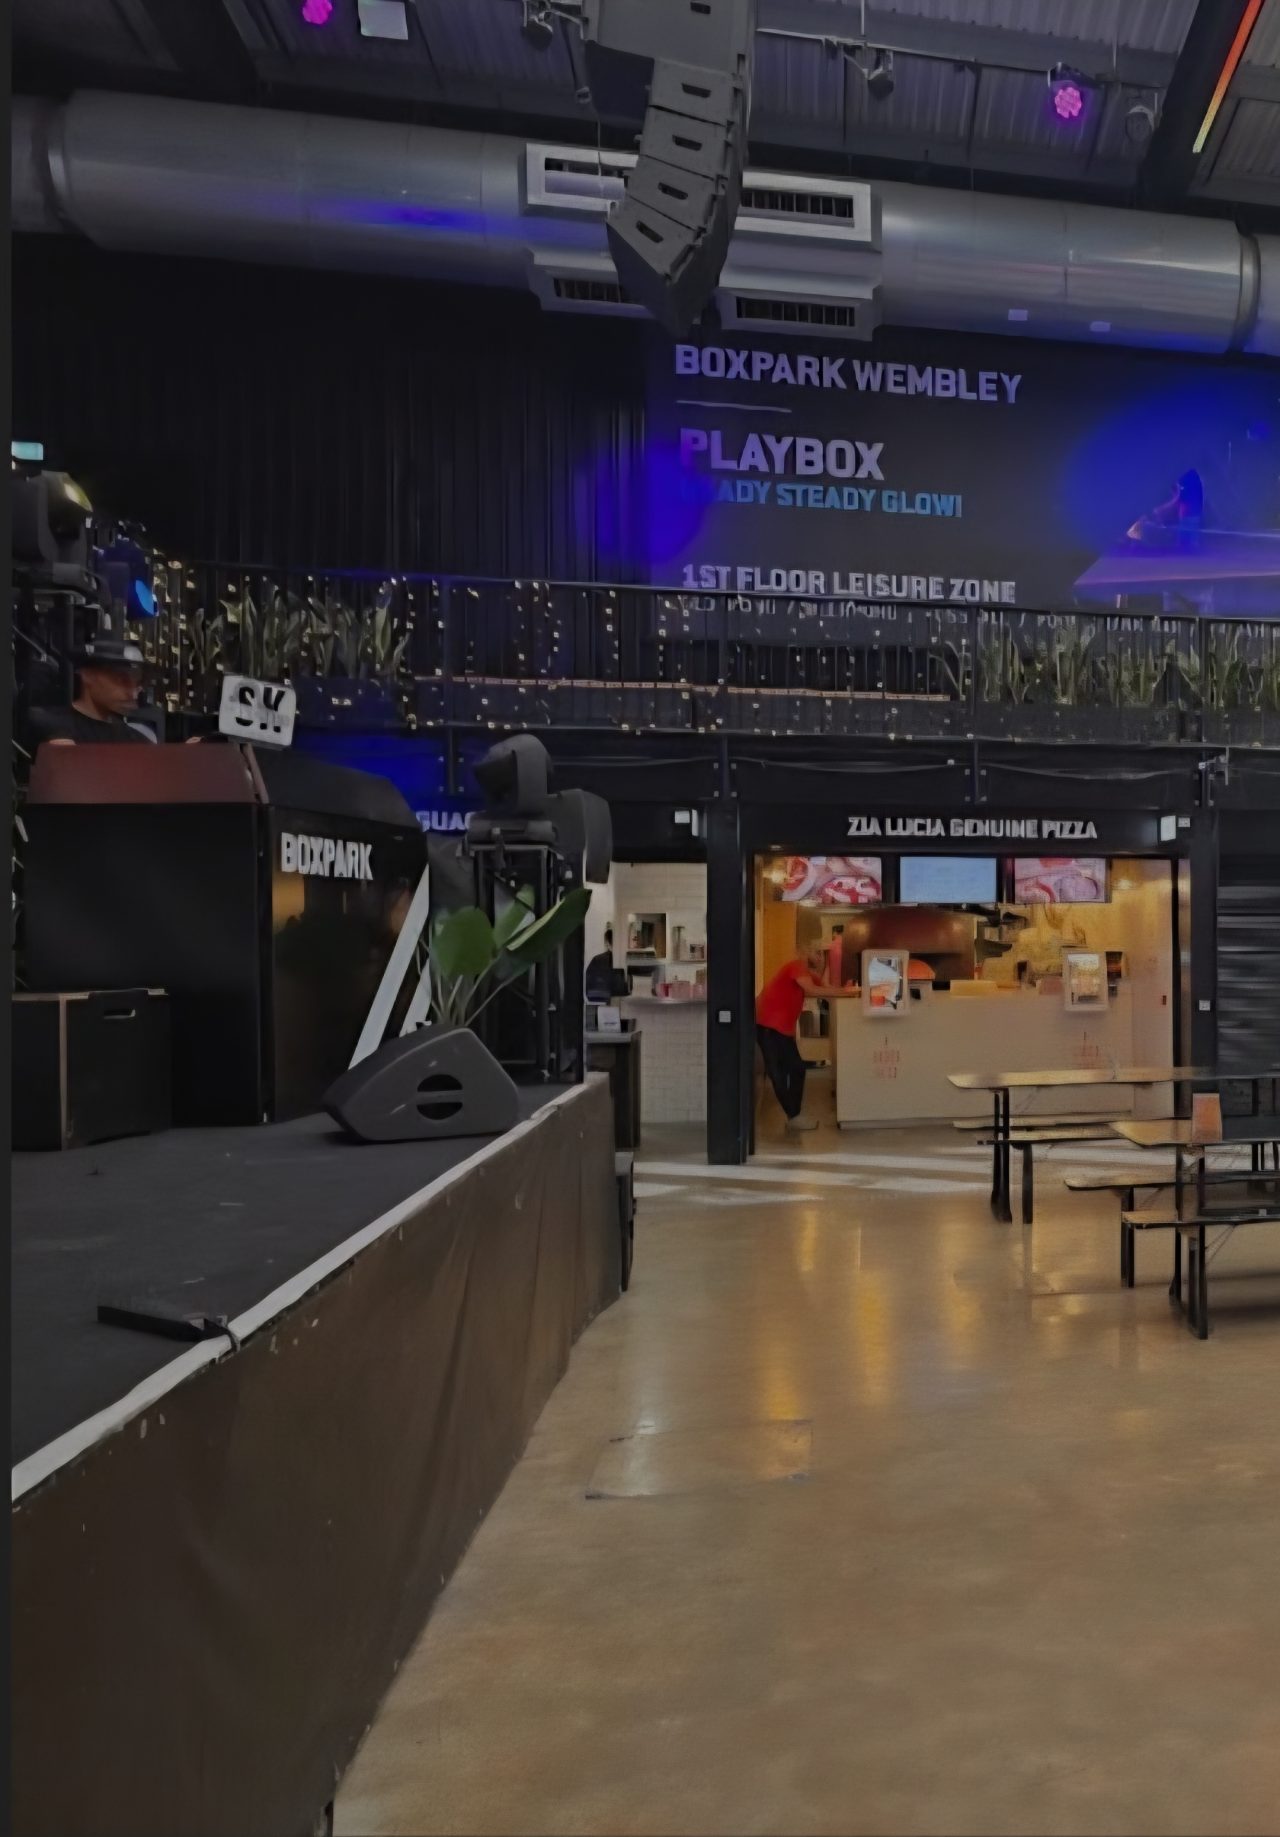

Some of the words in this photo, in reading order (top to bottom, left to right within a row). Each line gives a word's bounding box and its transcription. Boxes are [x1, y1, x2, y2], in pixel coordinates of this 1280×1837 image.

[676, 344, 847, 389] BOXPARK
[853, 360, 1022, 403] WEMBLEY
[680, 428, 884, 481] PLAYBOX
[776, 484, 876, 512] STEADY
[683, 564, 731, 590] 1ST
[737, 567, 825, 595] FLOOR
[833, 572, 945, 601] LEISURE
[950, 578, 1016, 604] ZONE
[847, 816, 882, 836] ZIA
[885, 817, 945, 837] LUCIA
[1042, 820, 1098, 839] PIZZA
[280, 832, 374, 881] BOXPARK
